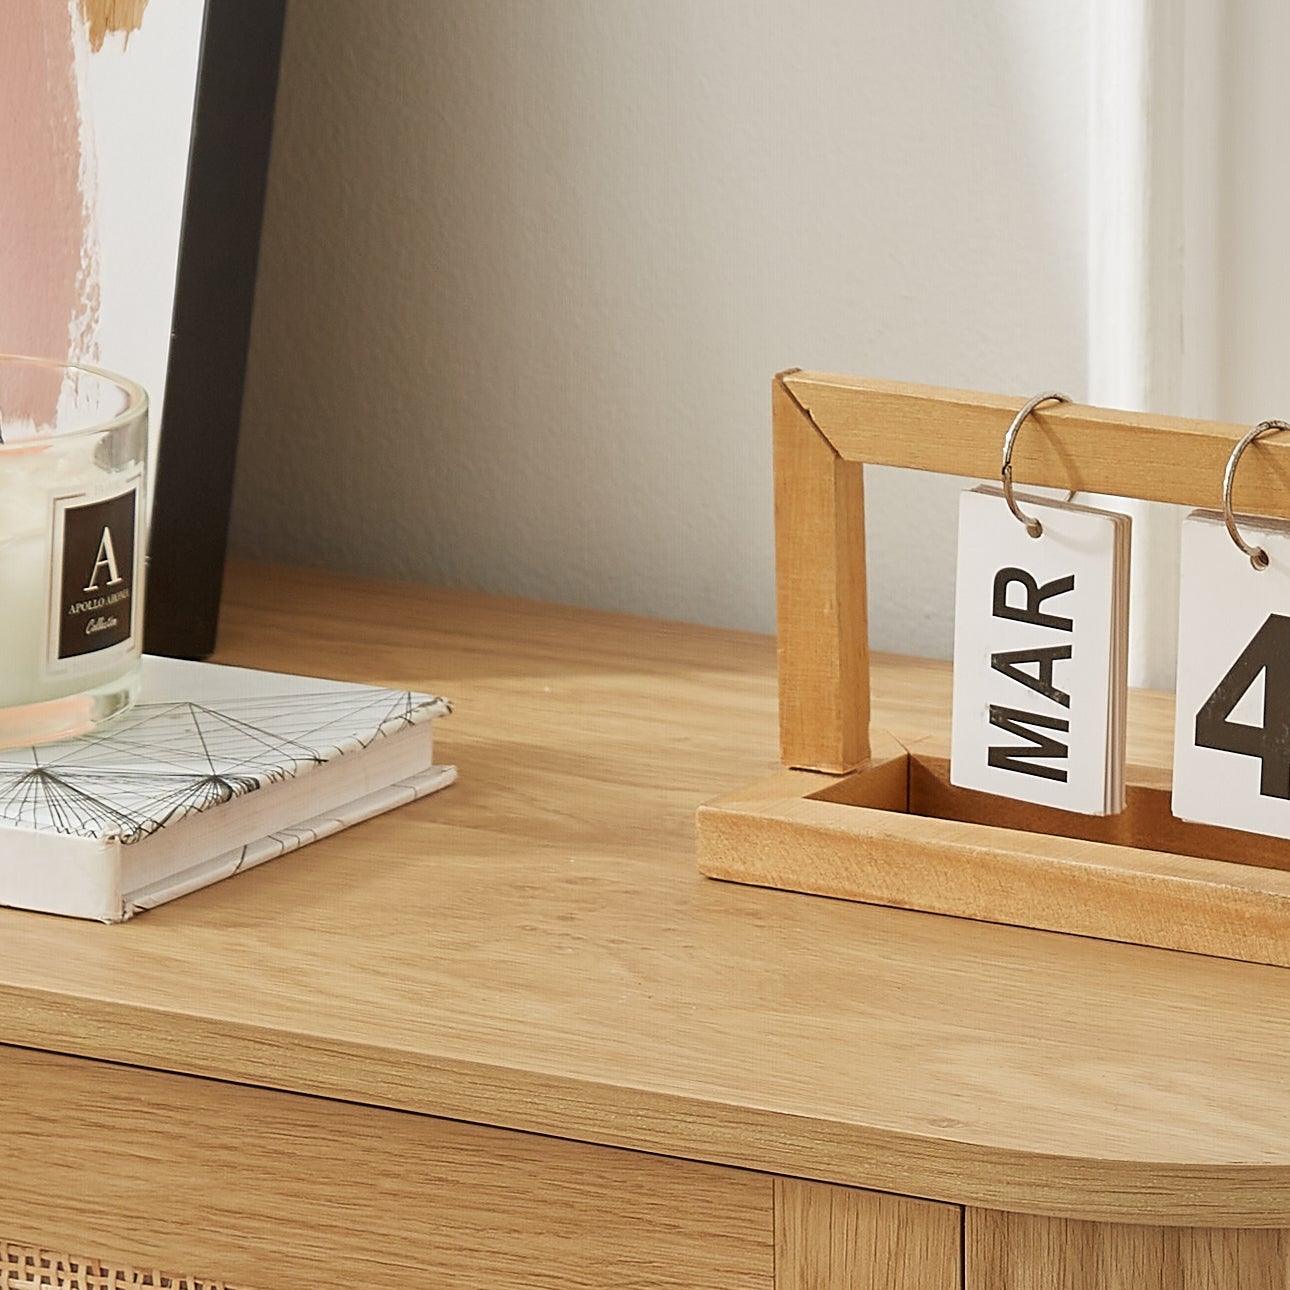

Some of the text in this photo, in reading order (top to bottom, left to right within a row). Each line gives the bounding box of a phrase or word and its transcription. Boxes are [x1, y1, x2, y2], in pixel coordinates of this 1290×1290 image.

[83, 526, 123, 591] A
[68, 597, 105, 615] APOLLO
[988, 567, 1075, 783] MAR
